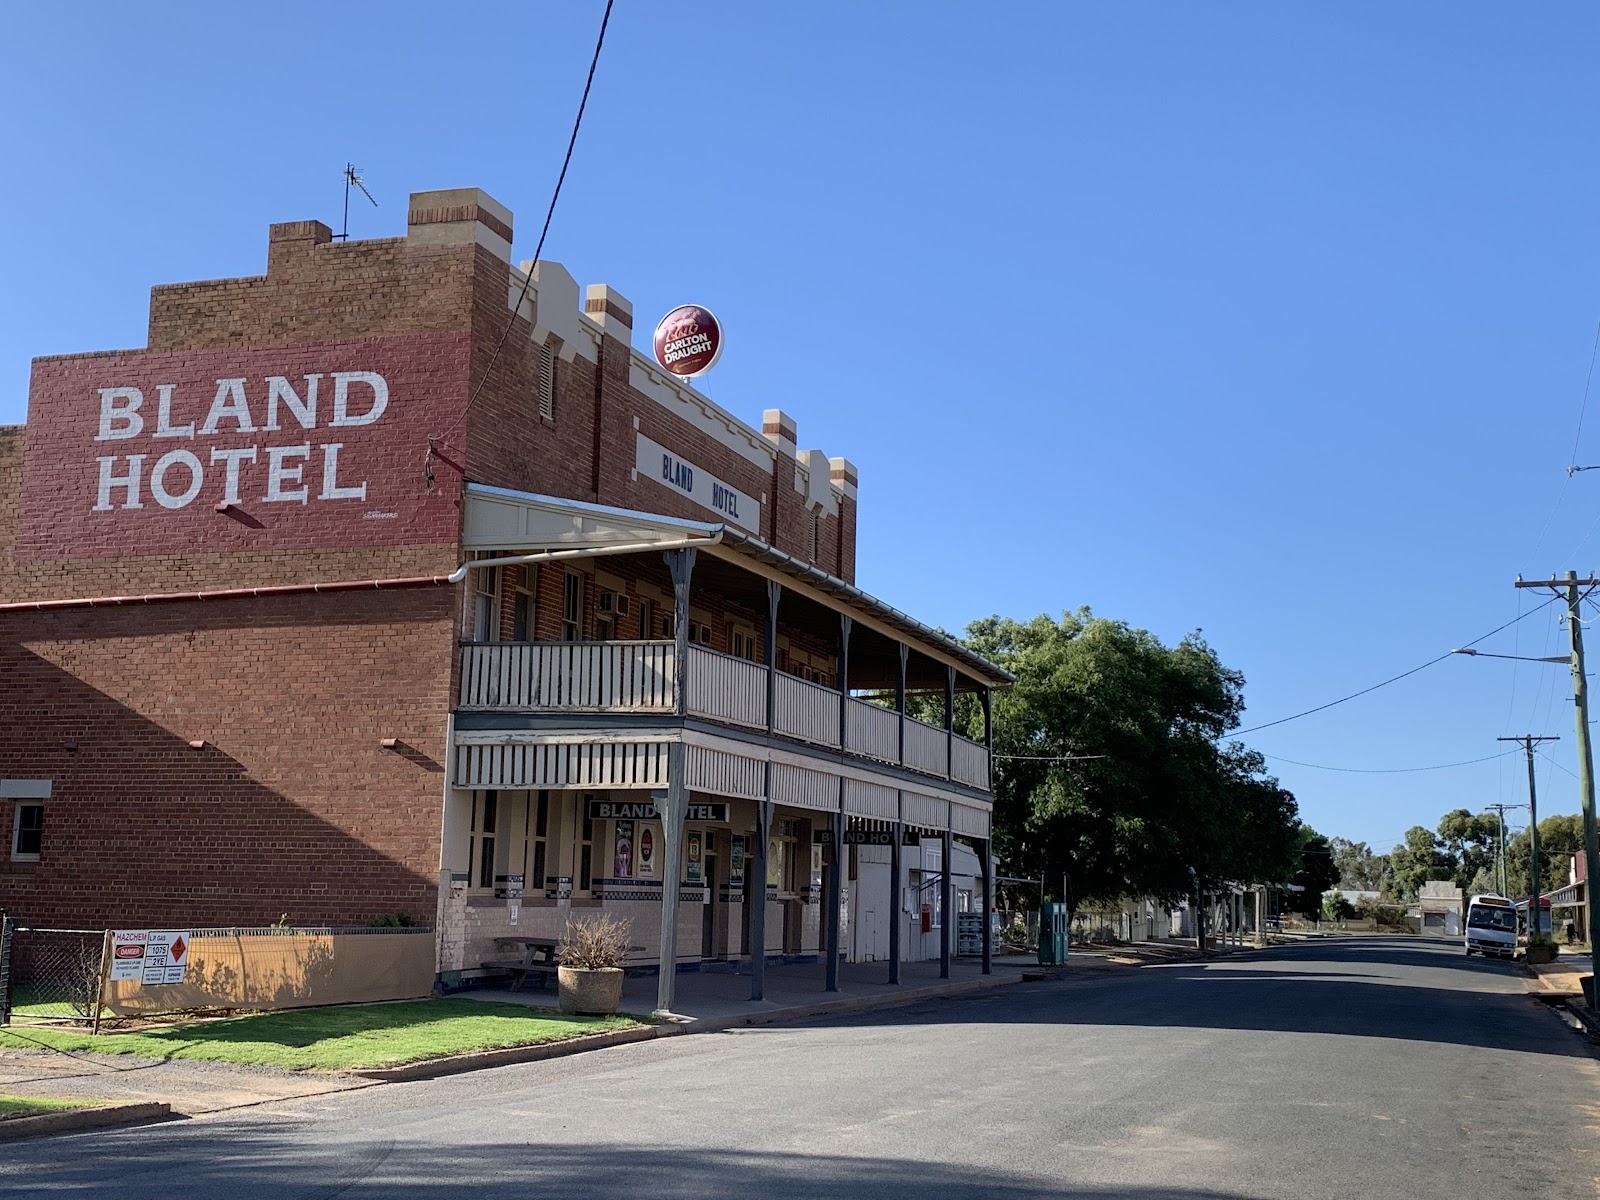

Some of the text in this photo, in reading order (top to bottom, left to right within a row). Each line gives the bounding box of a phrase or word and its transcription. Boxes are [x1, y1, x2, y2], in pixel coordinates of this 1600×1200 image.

[664, 333, 708, 353] CARLTON
[664, 341, 712, 364] DRAUGHT
[94, 371, 389, 441] BLAND
[92, 441, 367, 511] HOTEL
[663, 454, 739, 519] BLAND HOTEL
[600, 804, 657, 817] BLAND
[821, 832, 912, 844] BND HOL
[116, 932, 147, 941] HAZCHEM
[120, 948, 140, 956] DANGER
[152, 946, 167, 954] 1075
[152, 957, 165, 966] 2YE
